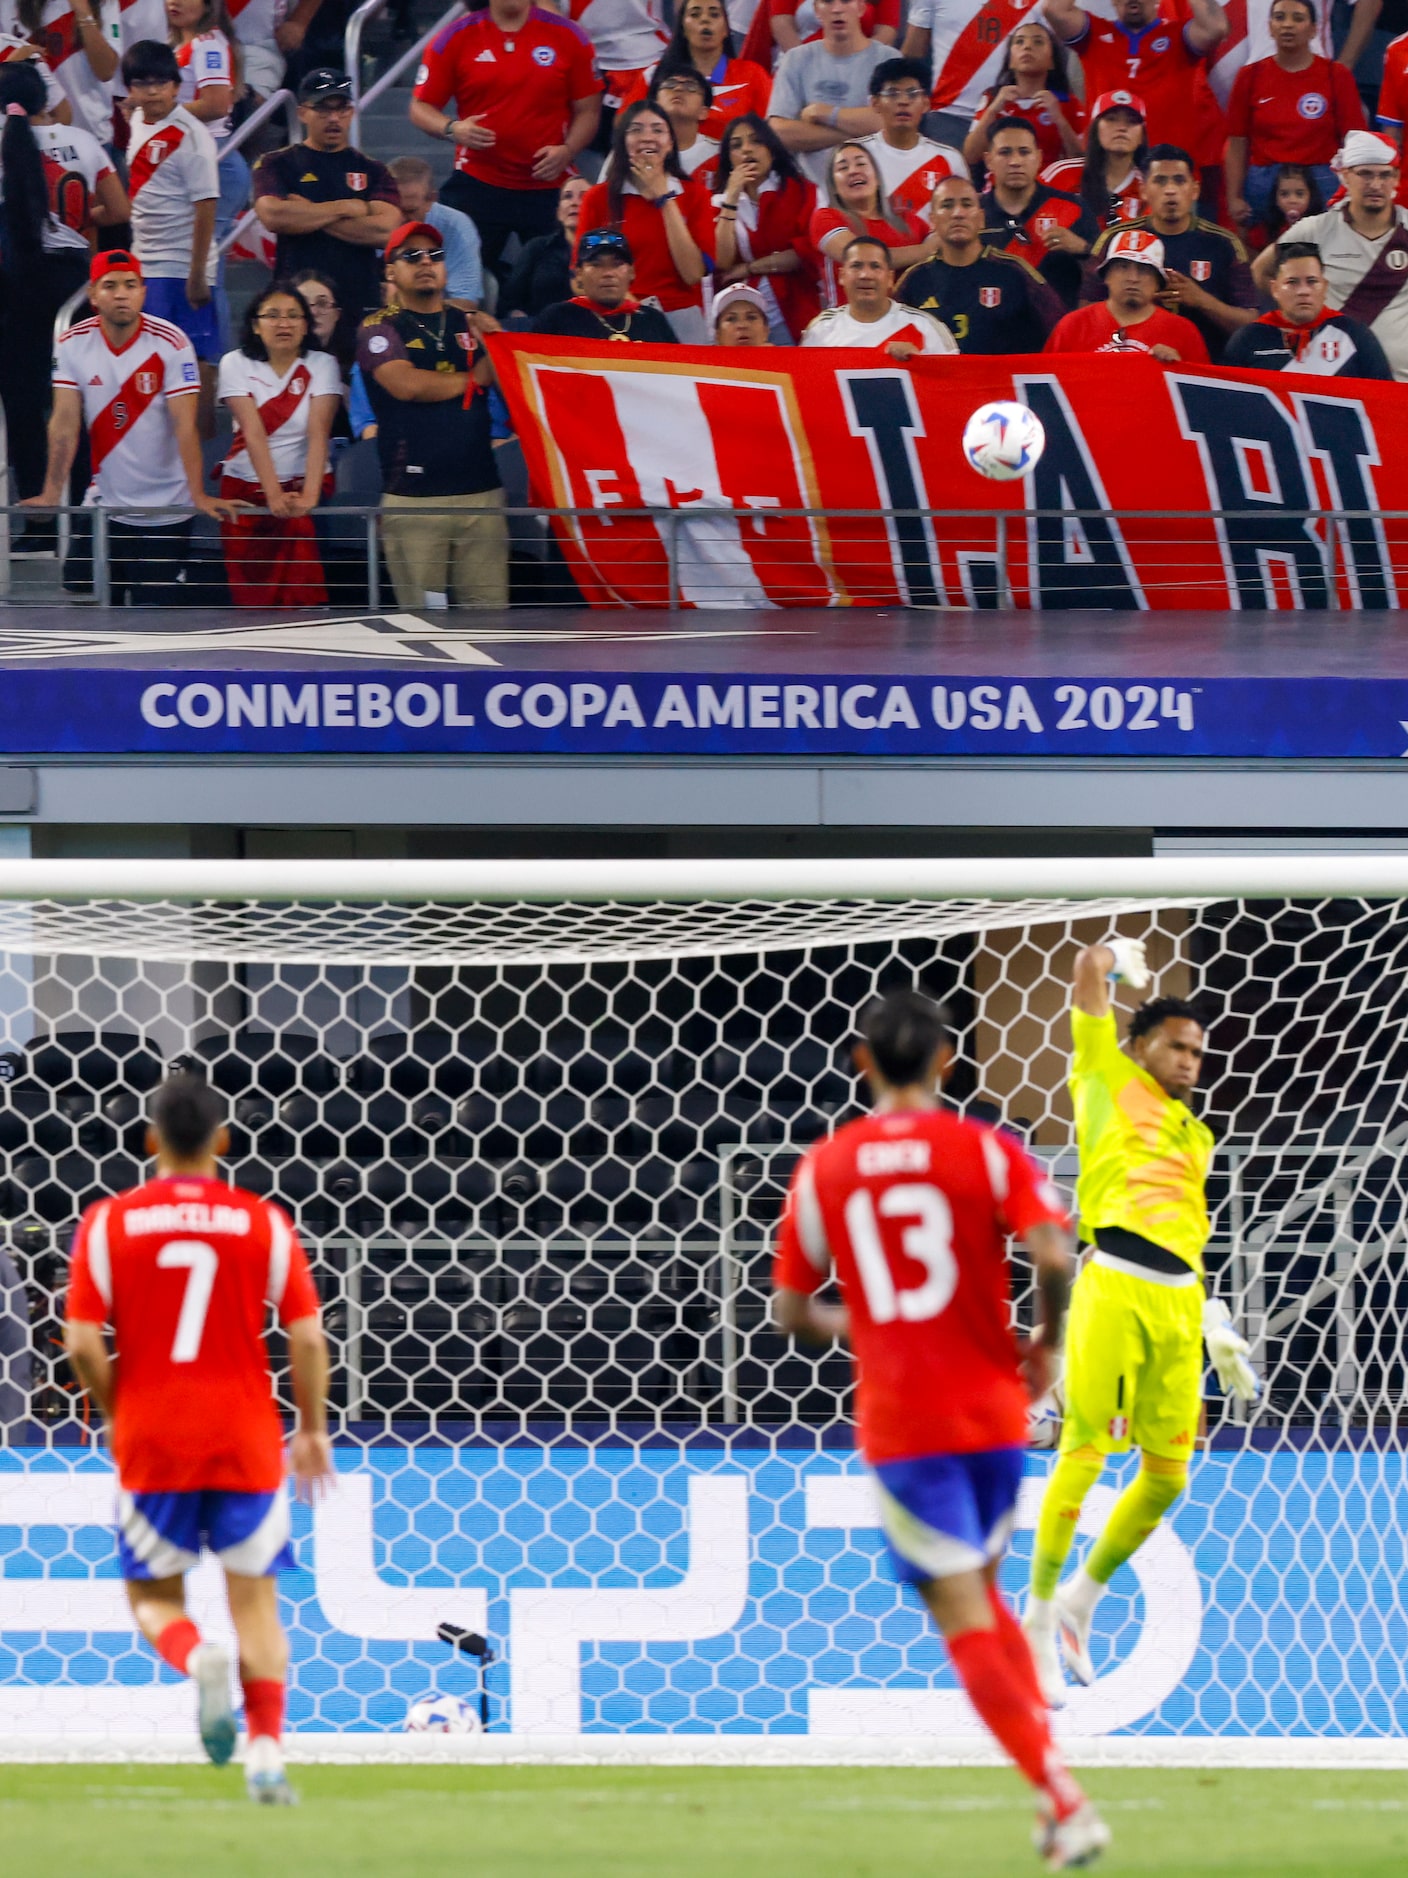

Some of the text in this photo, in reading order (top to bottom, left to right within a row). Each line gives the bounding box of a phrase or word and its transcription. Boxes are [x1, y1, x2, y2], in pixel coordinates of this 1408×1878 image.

[1126, 58, 1142, 79] 7
[141, 683, 473, 728] CONMEBOL
[486, 683, 645, 728] COPA
[654, 685, 919, 729] AMERICA
[933, 685, 1044, 732] USA
[844, 1182, 959, 1325] 13
[156, 1240, 219, 1363] 7
